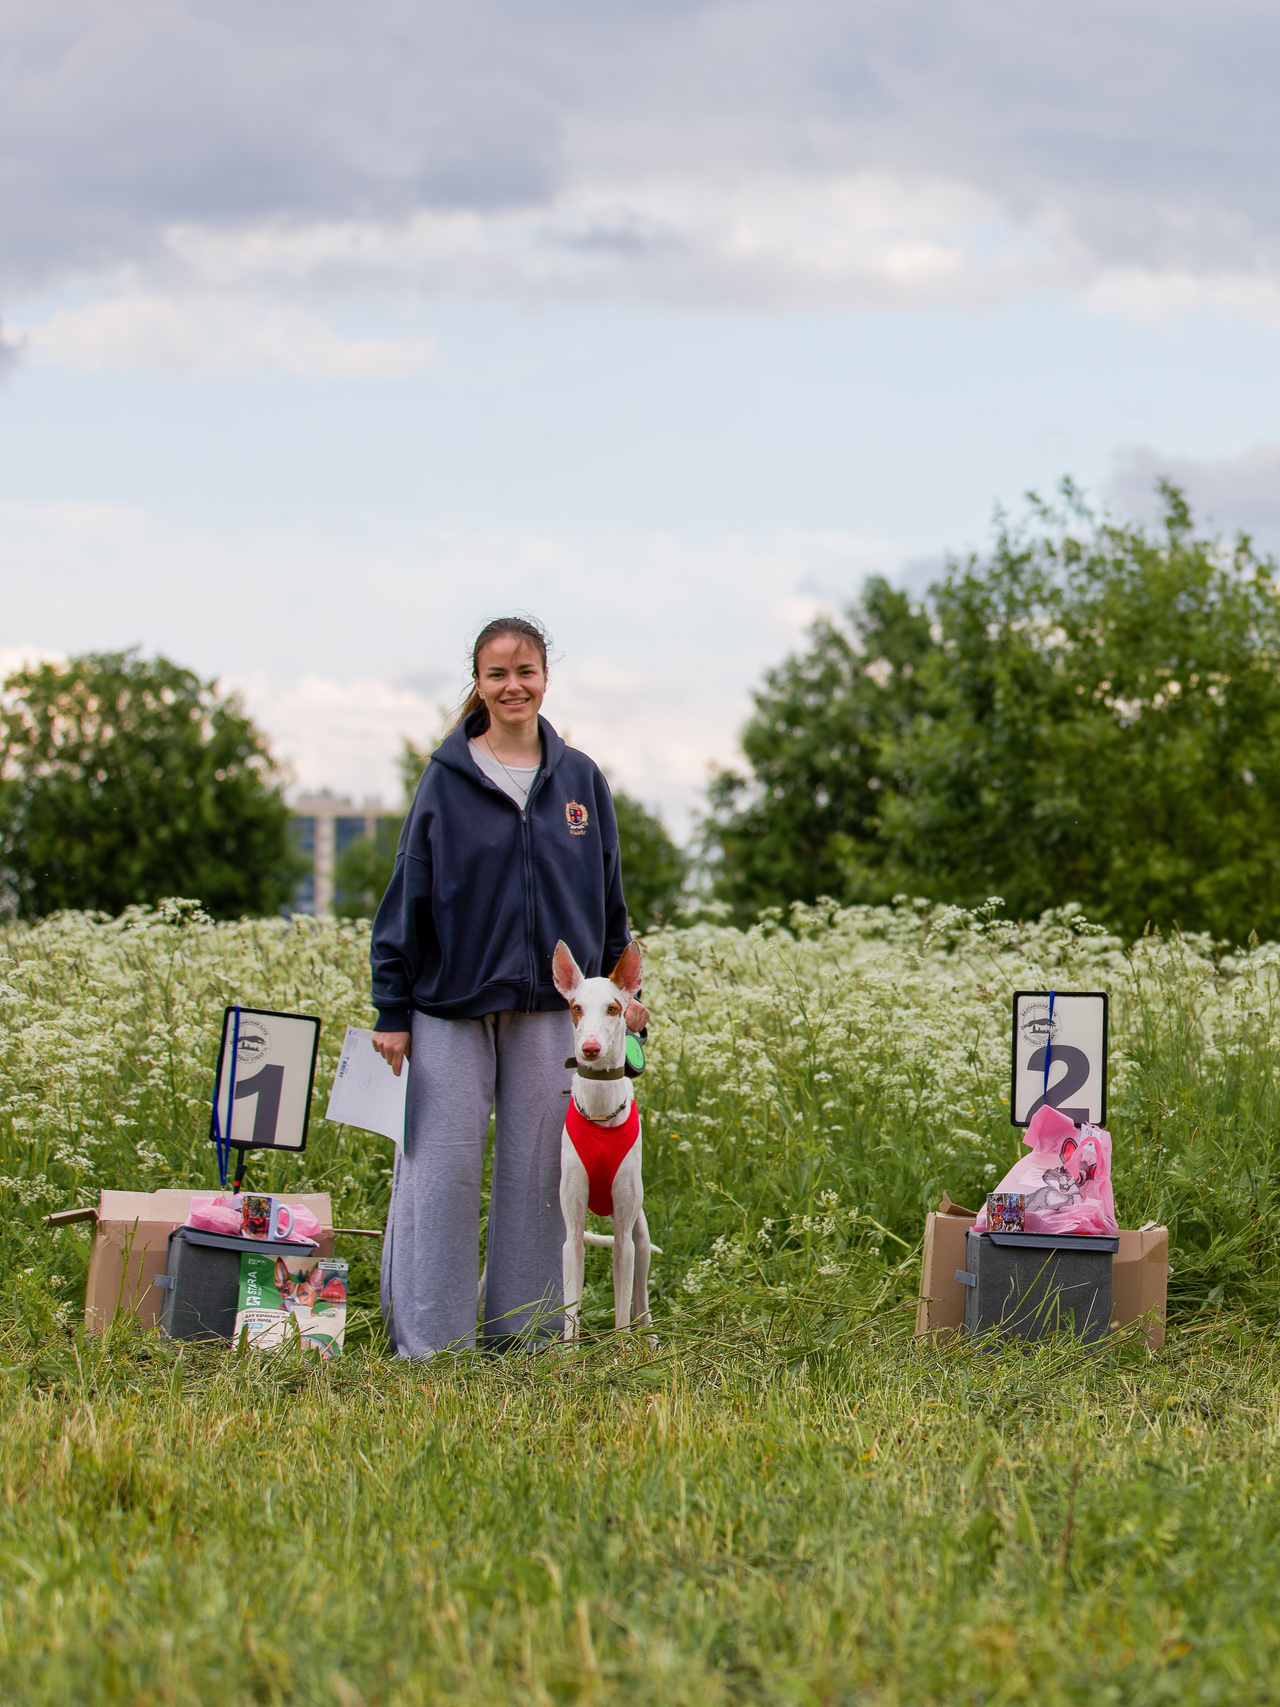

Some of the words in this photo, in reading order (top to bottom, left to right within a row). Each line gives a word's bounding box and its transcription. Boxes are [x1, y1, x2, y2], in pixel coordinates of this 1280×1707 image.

[235, 1064, 285, 1144] 1
[1025, 1045, 1090, 1124] 2
[247, 1271, 258, 1295] STARA
